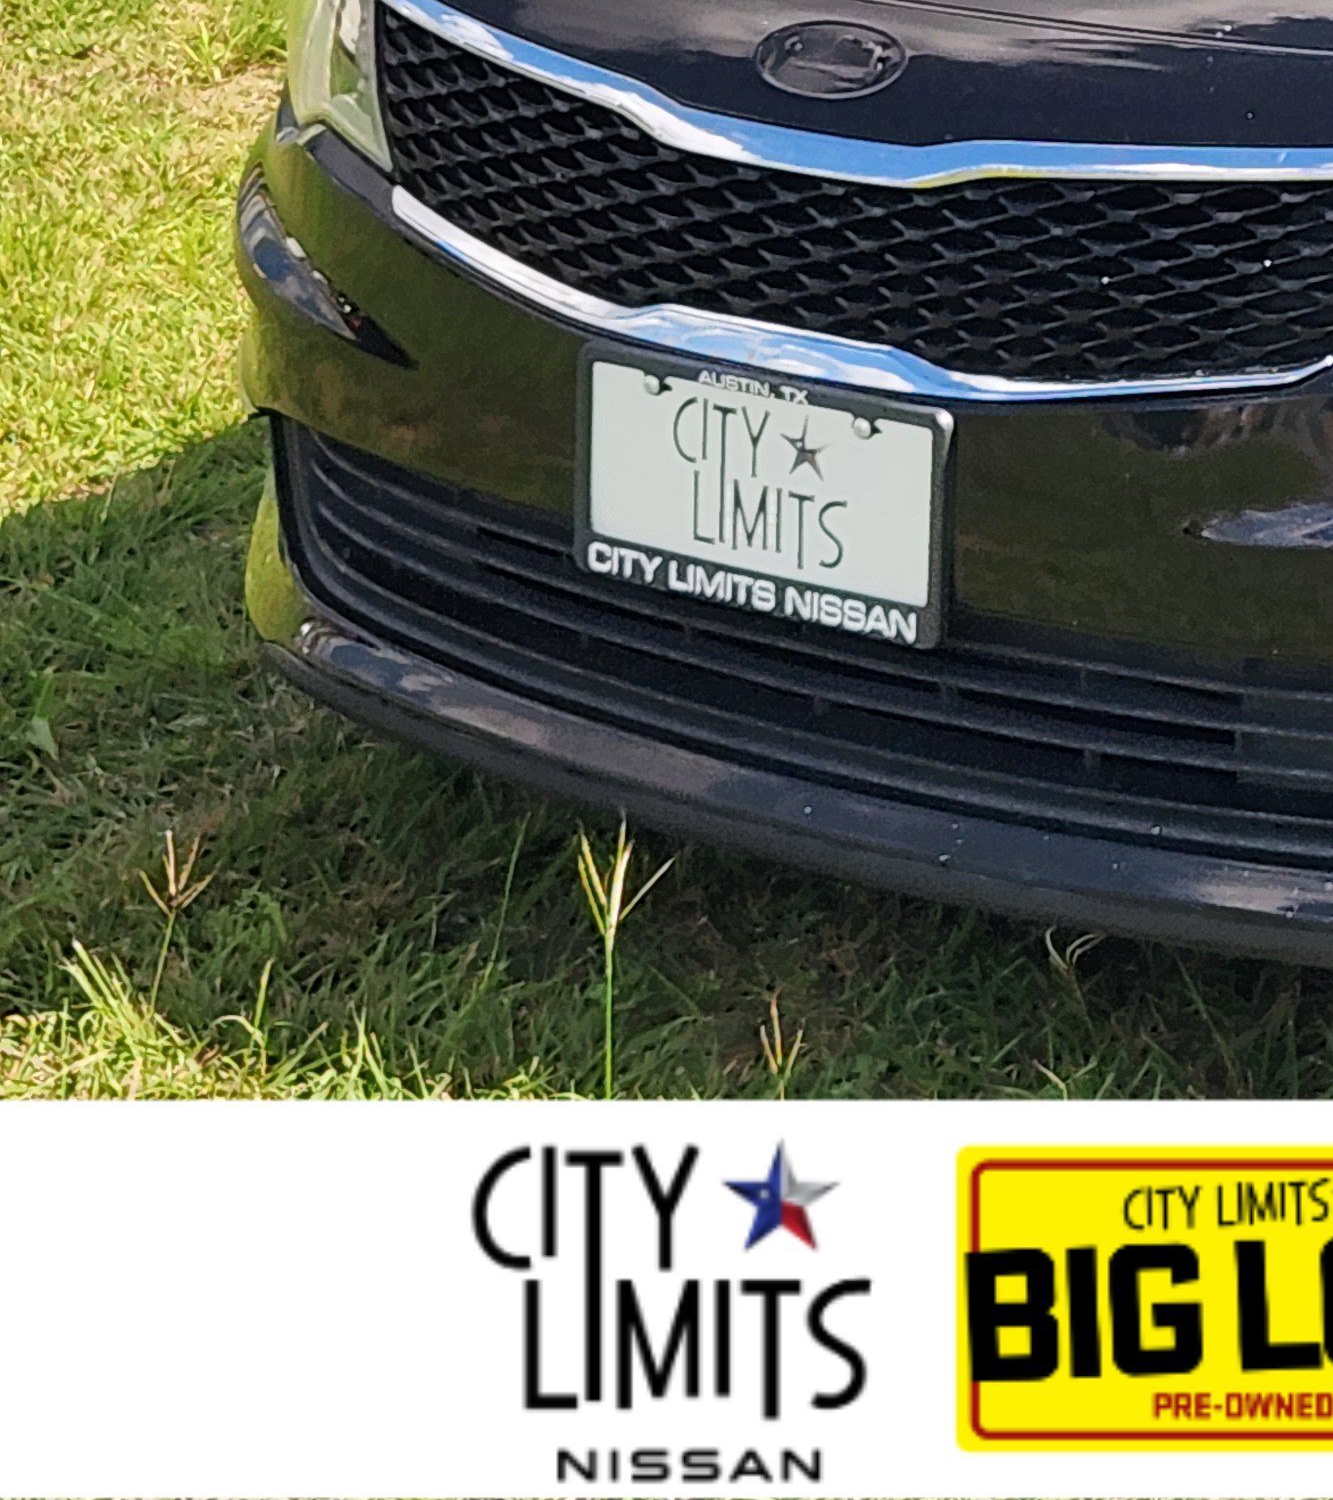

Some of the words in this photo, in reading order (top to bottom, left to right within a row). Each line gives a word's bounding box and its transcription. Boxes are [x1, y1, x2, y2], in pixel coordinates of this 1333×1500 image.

[698, 370, 777, 399] AUSTIN,
[779, 384, 810, 406] TX
[672, 396, 772, 480] CITY
[692, 469, 848, 570] LIMITS
[587, 540, 664, 583] CITY
[666, 558, 778, 612] LIMITS
[783, 586, 917, 644] NISSAN
